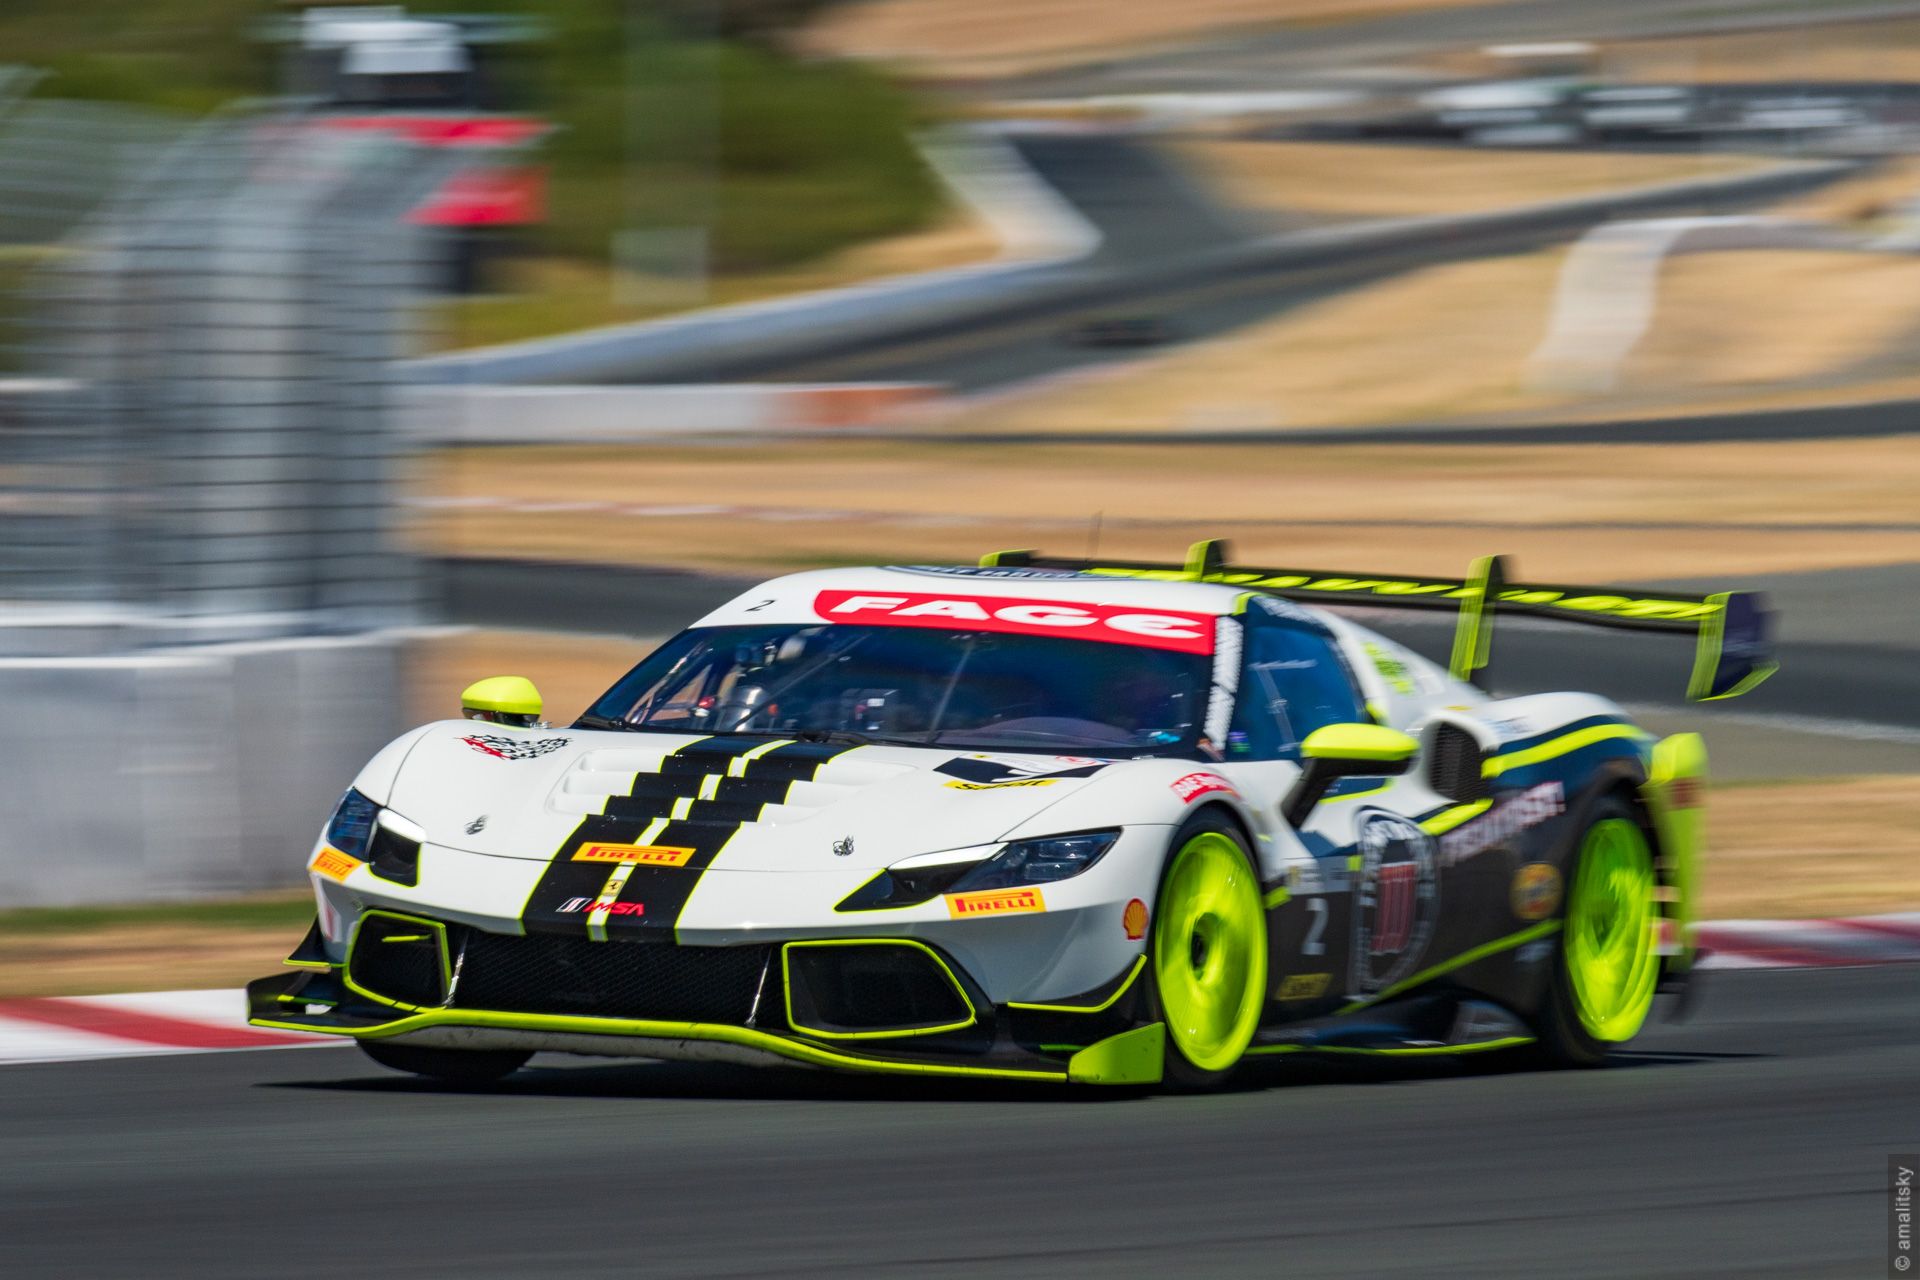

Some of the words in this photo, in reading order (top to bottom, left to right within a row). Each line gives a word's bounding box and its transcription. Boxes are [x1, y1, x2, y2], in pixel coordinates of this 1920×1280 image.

[743, 598, 777, 612] 2
[829, 596, 1205, 639] FAGE
[315, 850, 354, 876] PIRELLI
[586, 846, 682, 862] PIRELLI
[582, 901, 645, 916] IMSA
[954, 892, 1034, 913] PIRELLI
[1301, 897, 1330, 956] 2
